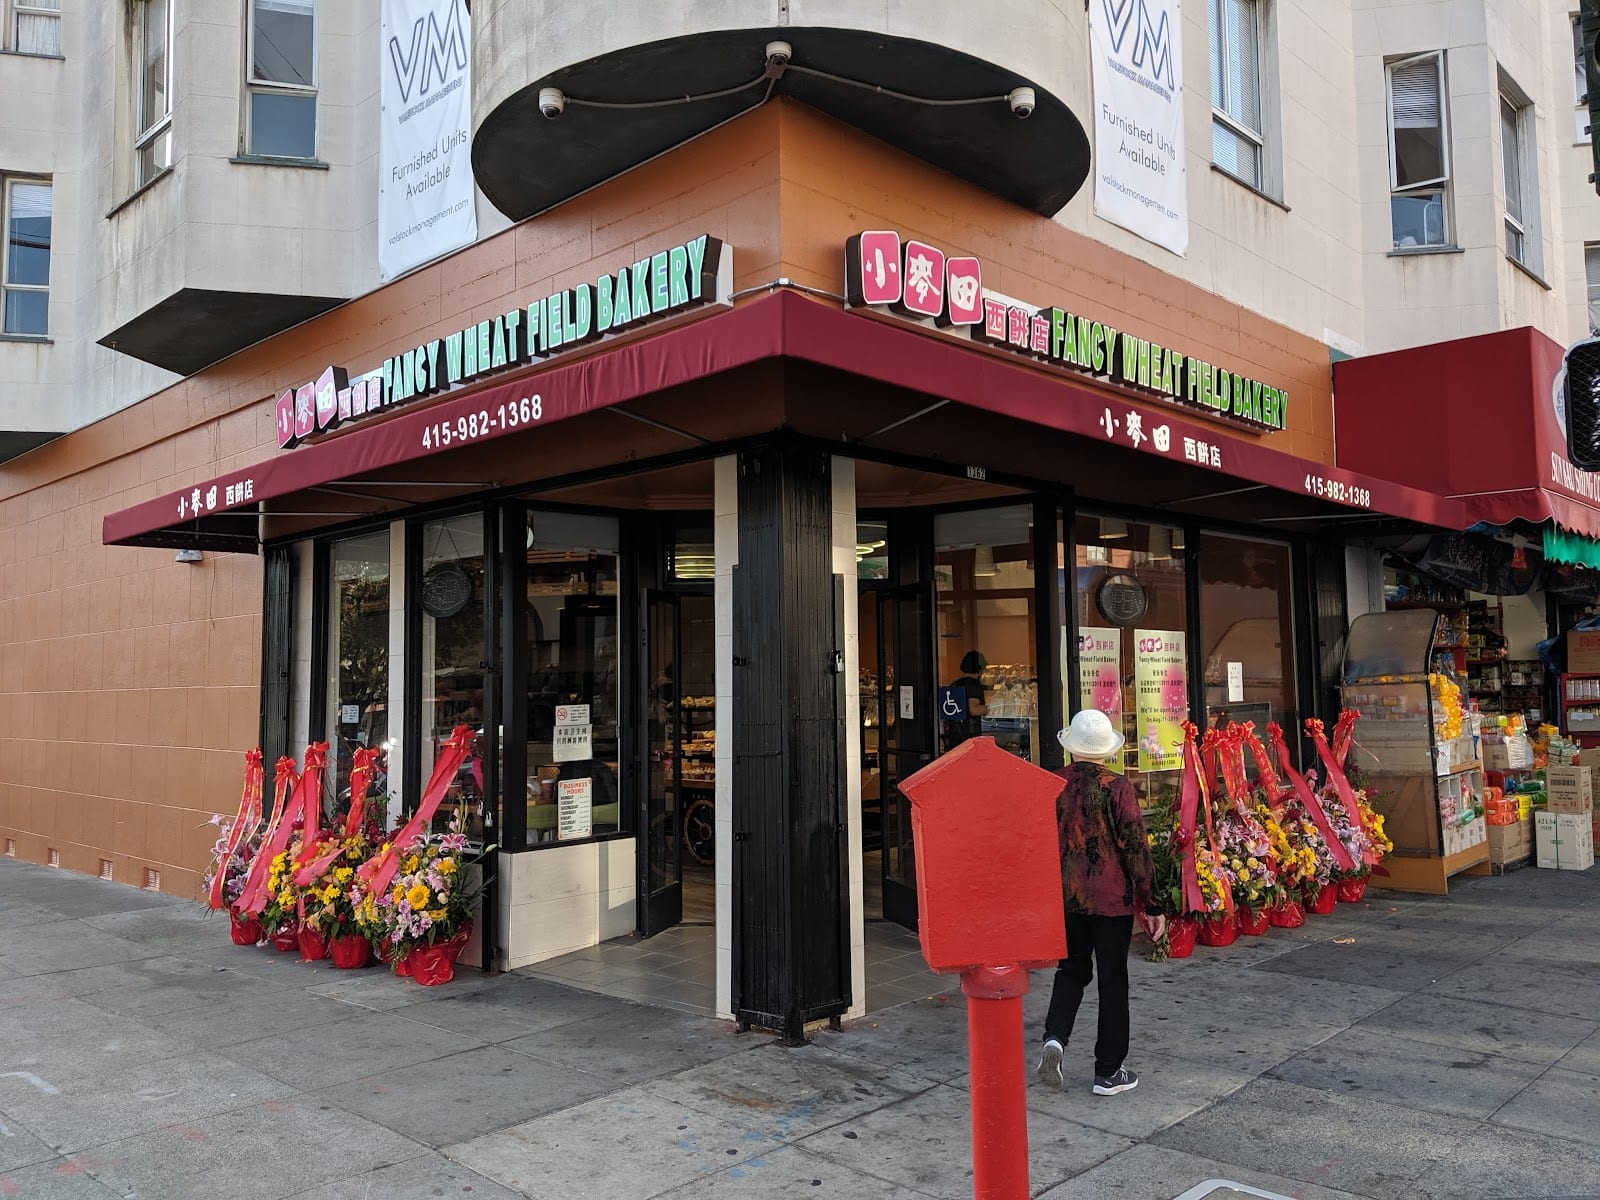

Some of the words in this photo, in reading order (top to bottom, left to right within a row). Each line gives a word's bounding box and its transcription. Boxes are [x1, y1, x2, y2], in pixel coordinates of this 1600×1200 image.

[389, 0, 467, 103] VM
[1103, 0, 1174, 91] VM
[1102, 103, 1153, 144] Furnished
[392, 140, 438, 183] Furnished
[441, 129, 467, 154] Units
[405, 162, 451, 200] Available
[1119, 139, 1166, 176] Available
[383, 339, 440, 405] FANCY
[445, 309, 520, 383] WHEAT
[527, 283, 591, 356] FIELD
[597, 234, 708, 332] BAKERY
[1052, 307, 1117, 375] FANCY
[1122, 332, 1183, 397] WHEAT
[1187, 356, 1231, 412] FIELD
[1233, 373, 1289, 430] BAKERY
[422, 394, 542, 449] 415-982-1368
[967, 465, 986, 480] 1362
[1305, 474, 1370, 508] 415-982-1368
